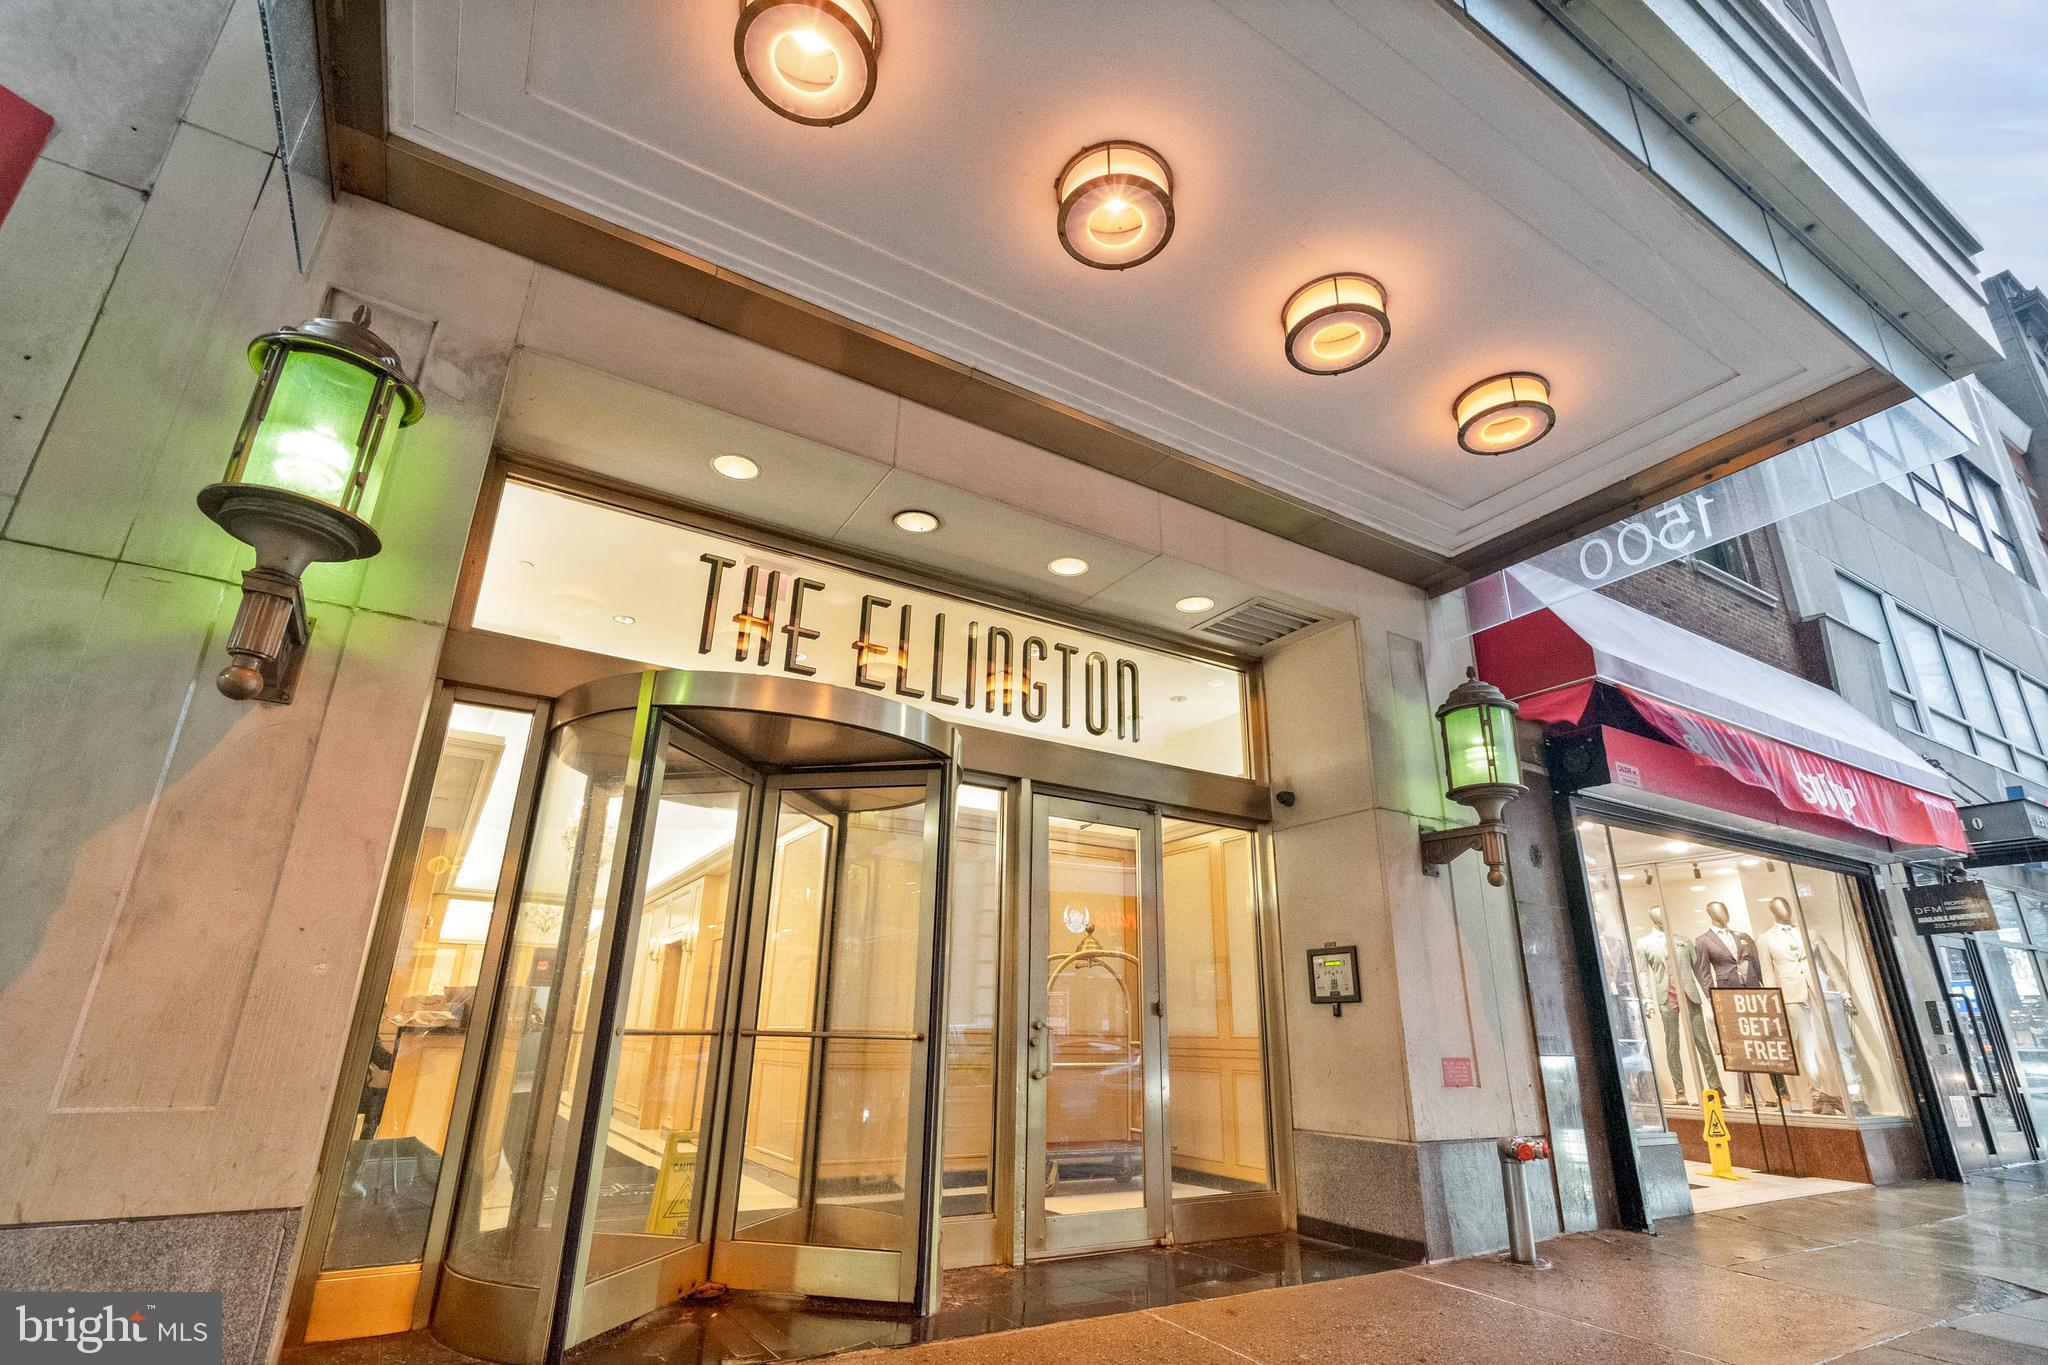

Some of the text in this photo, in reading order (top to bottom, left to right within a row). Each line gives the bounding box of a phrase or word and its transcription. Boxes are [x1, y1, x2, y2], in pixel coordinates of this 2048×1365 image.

[699, 553, 1140, 743] THE ELLINGTON
[1914, 906, 1942, 915] DFM
[1733, 994, 1782, 1014] BUY 1
[1738, 1016, 1783, 1037] GET 1
[1743, 1039, 1790, 1061] FREE
